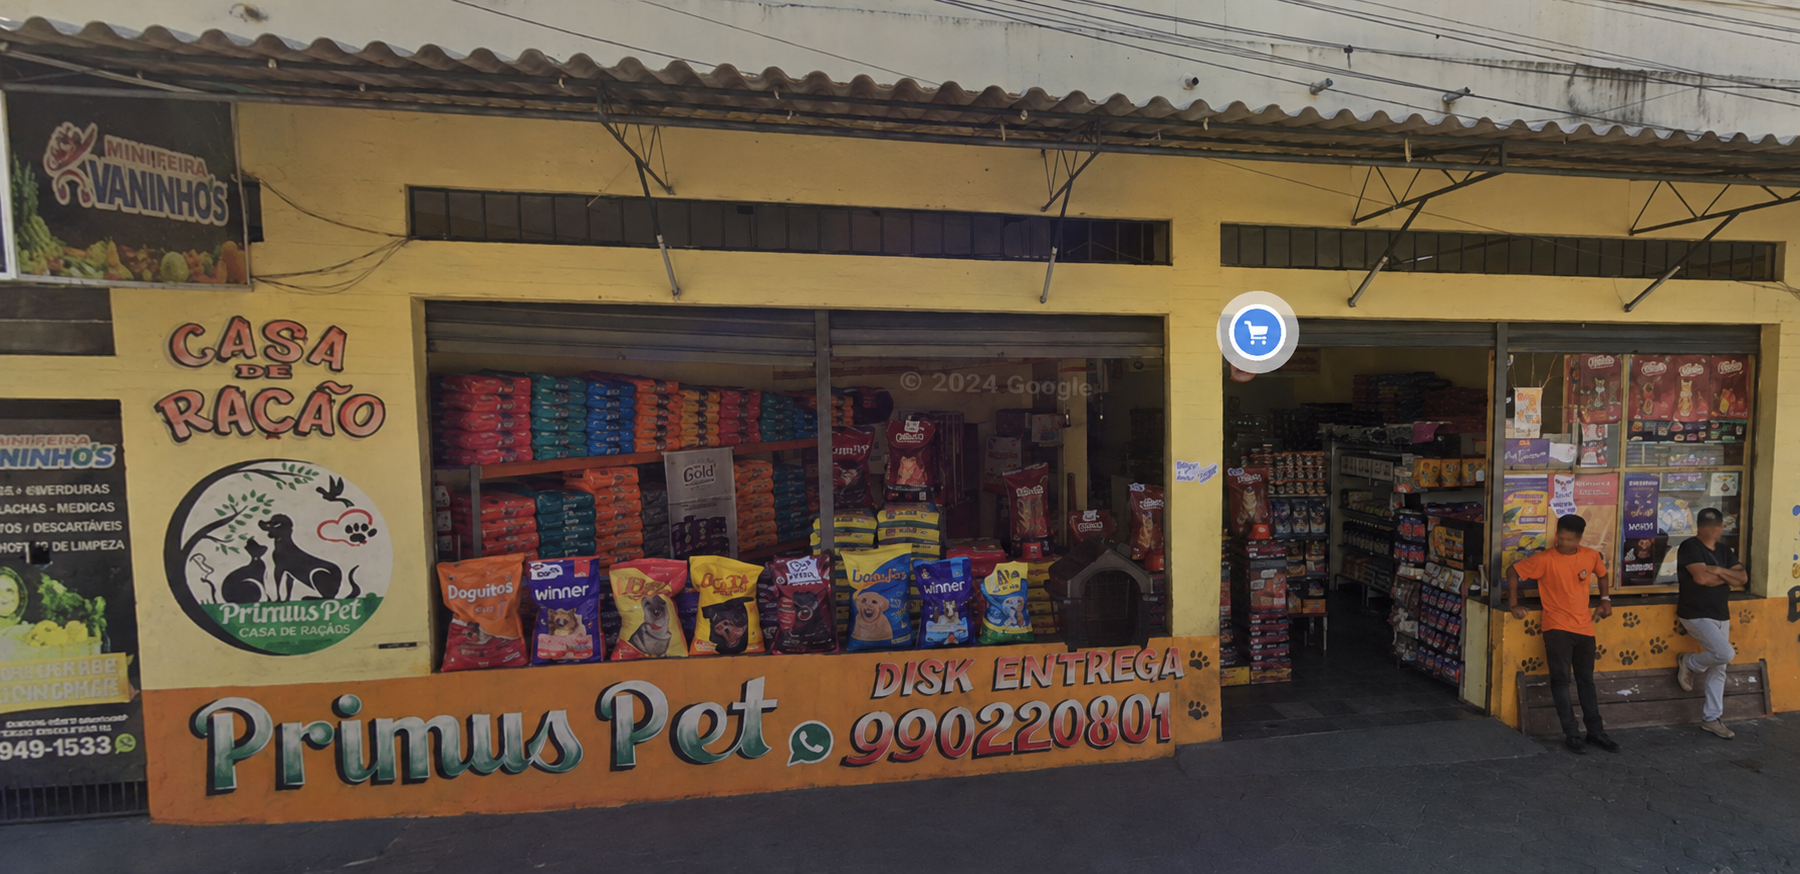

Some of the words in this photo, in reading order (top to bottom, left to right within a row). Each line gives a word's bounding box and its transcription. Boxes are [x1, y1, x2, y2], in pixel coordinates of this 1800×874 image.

[106, 140, 153, 167] MINI
[156, 152, 206, 177] FEIRA
[168, 315, 348, 373] CASA
[234, 363, 293, 380] DE
[154, 380, 386, 443] RAÇÃO
[35, 436, 90, 446] FEIRA
[683, 464, 713, 483] Gold
[57, 502, 115, 513] MEDICAS
[33, 519, 123, 533] DESCARTÁVEIS
[52, 541, 69, 552] DE
[71, 540, 125, 552] LIMPEZA
[447, 582, 513, 603] Doguitos
[534, 585, 590, 601] winner
[923, 580, 965, 594] winner
[320, 599, 362, 621] Pet
[239, 627, 277, 638] CASA
[280, 627, 297, 636] DE
[872, 658, 977, 699] DISK
[991, 647, 1185, 691] ENTREGA
[190, 695, 583, 797] Primus
[595, 675, 778, 772] Pet
[840, 691, 1171, 768] 990220801
